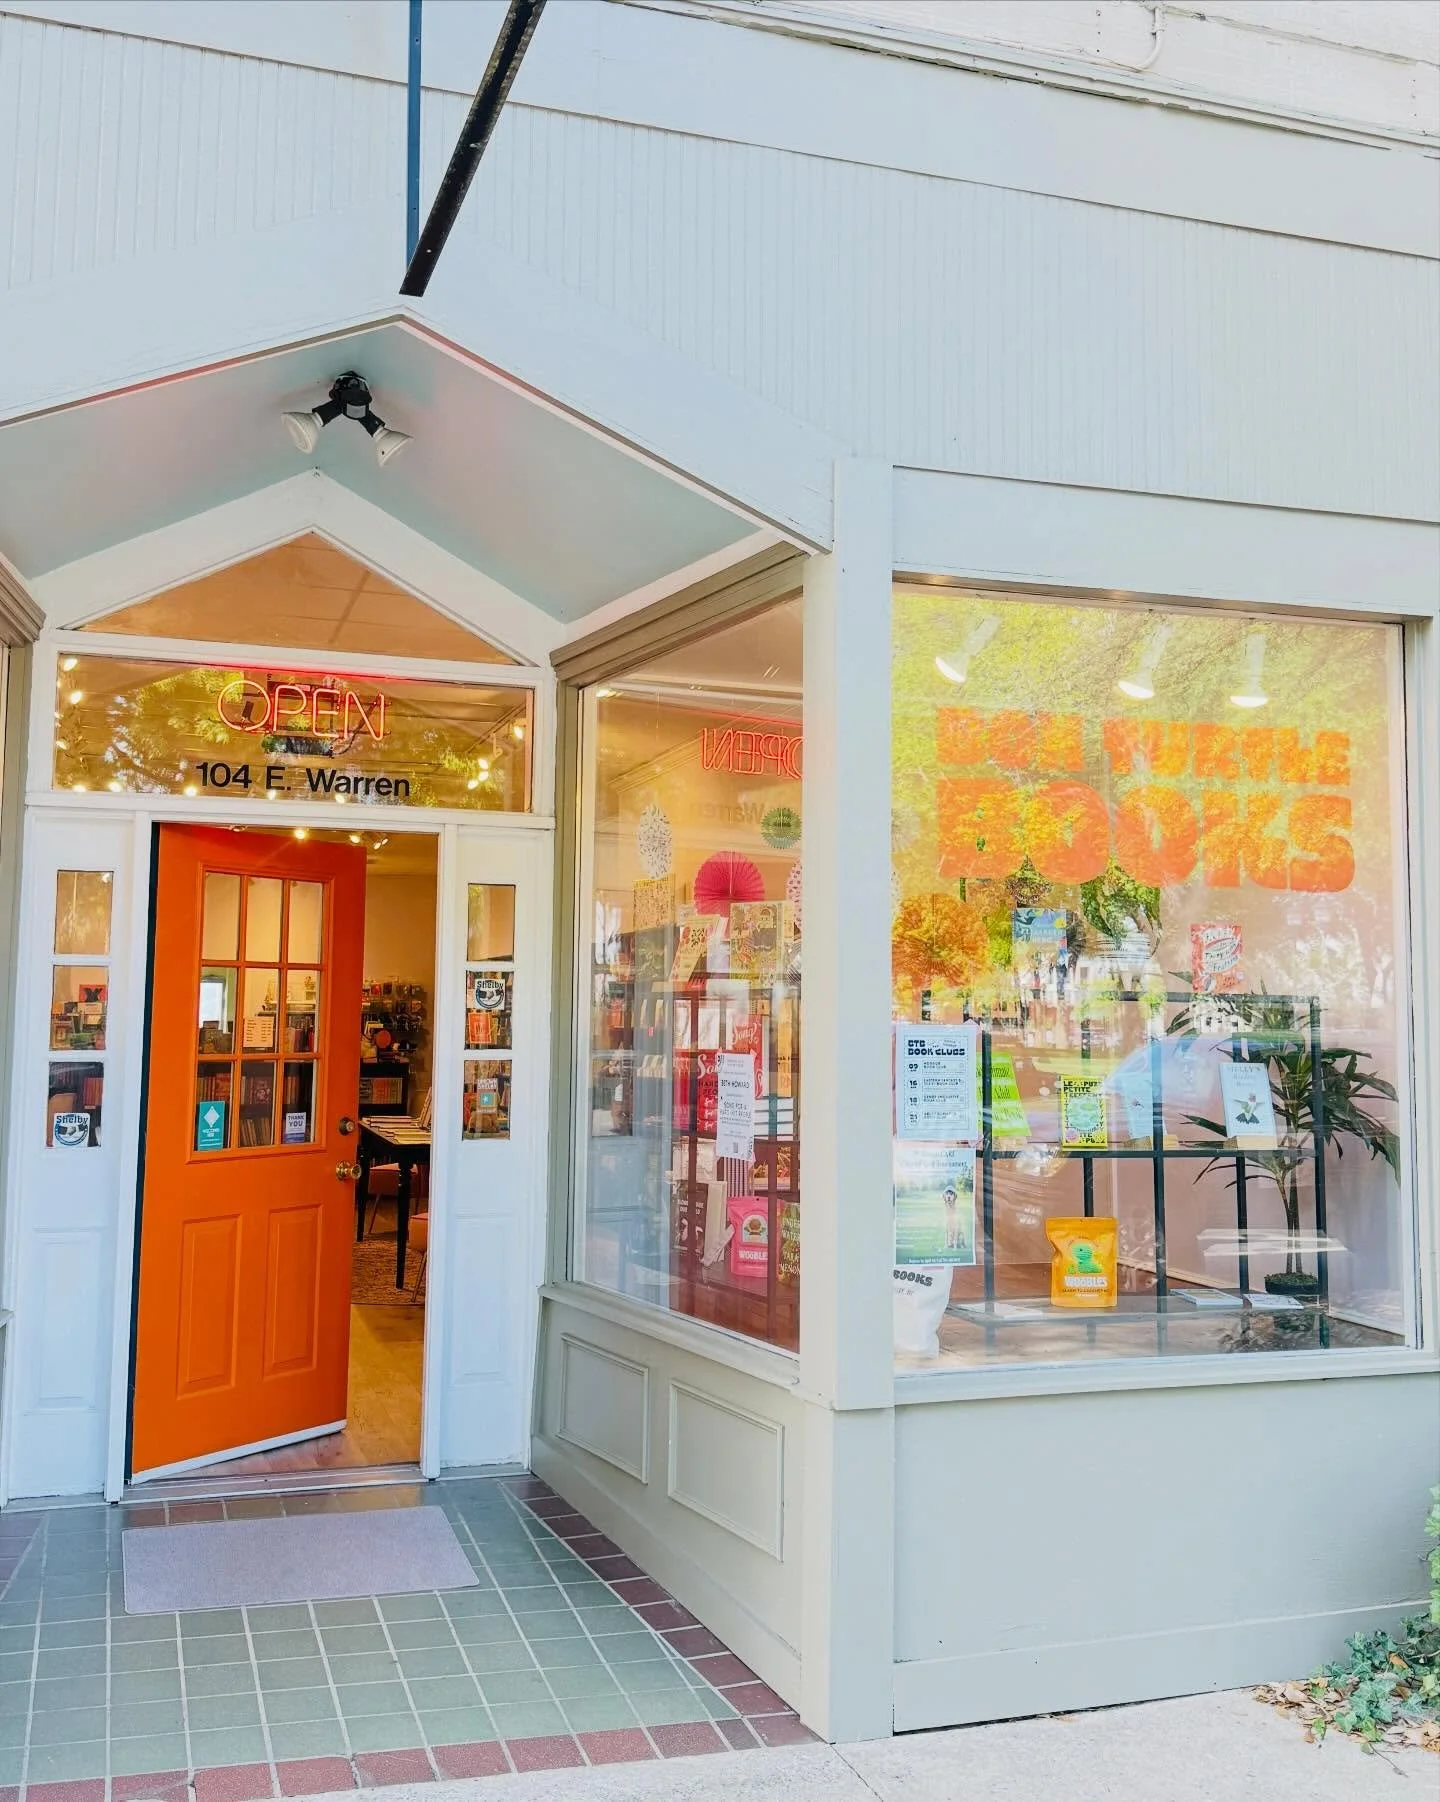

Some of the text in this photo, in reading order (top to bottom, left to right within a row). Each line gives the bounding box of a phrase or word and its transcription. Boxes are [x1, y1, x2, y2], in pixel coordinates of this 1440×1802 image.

[217, 679, 386, 742] OPEN
[196, 761, 410, 797] 104 E. Warren
[935, 777, 1356, 893] BOOKS
[477, 980, 504, 990] Shelby
[908, 1048, 966, 1056] BOOK CLUBS
[56, 1115, 89, 1125] Shelby
